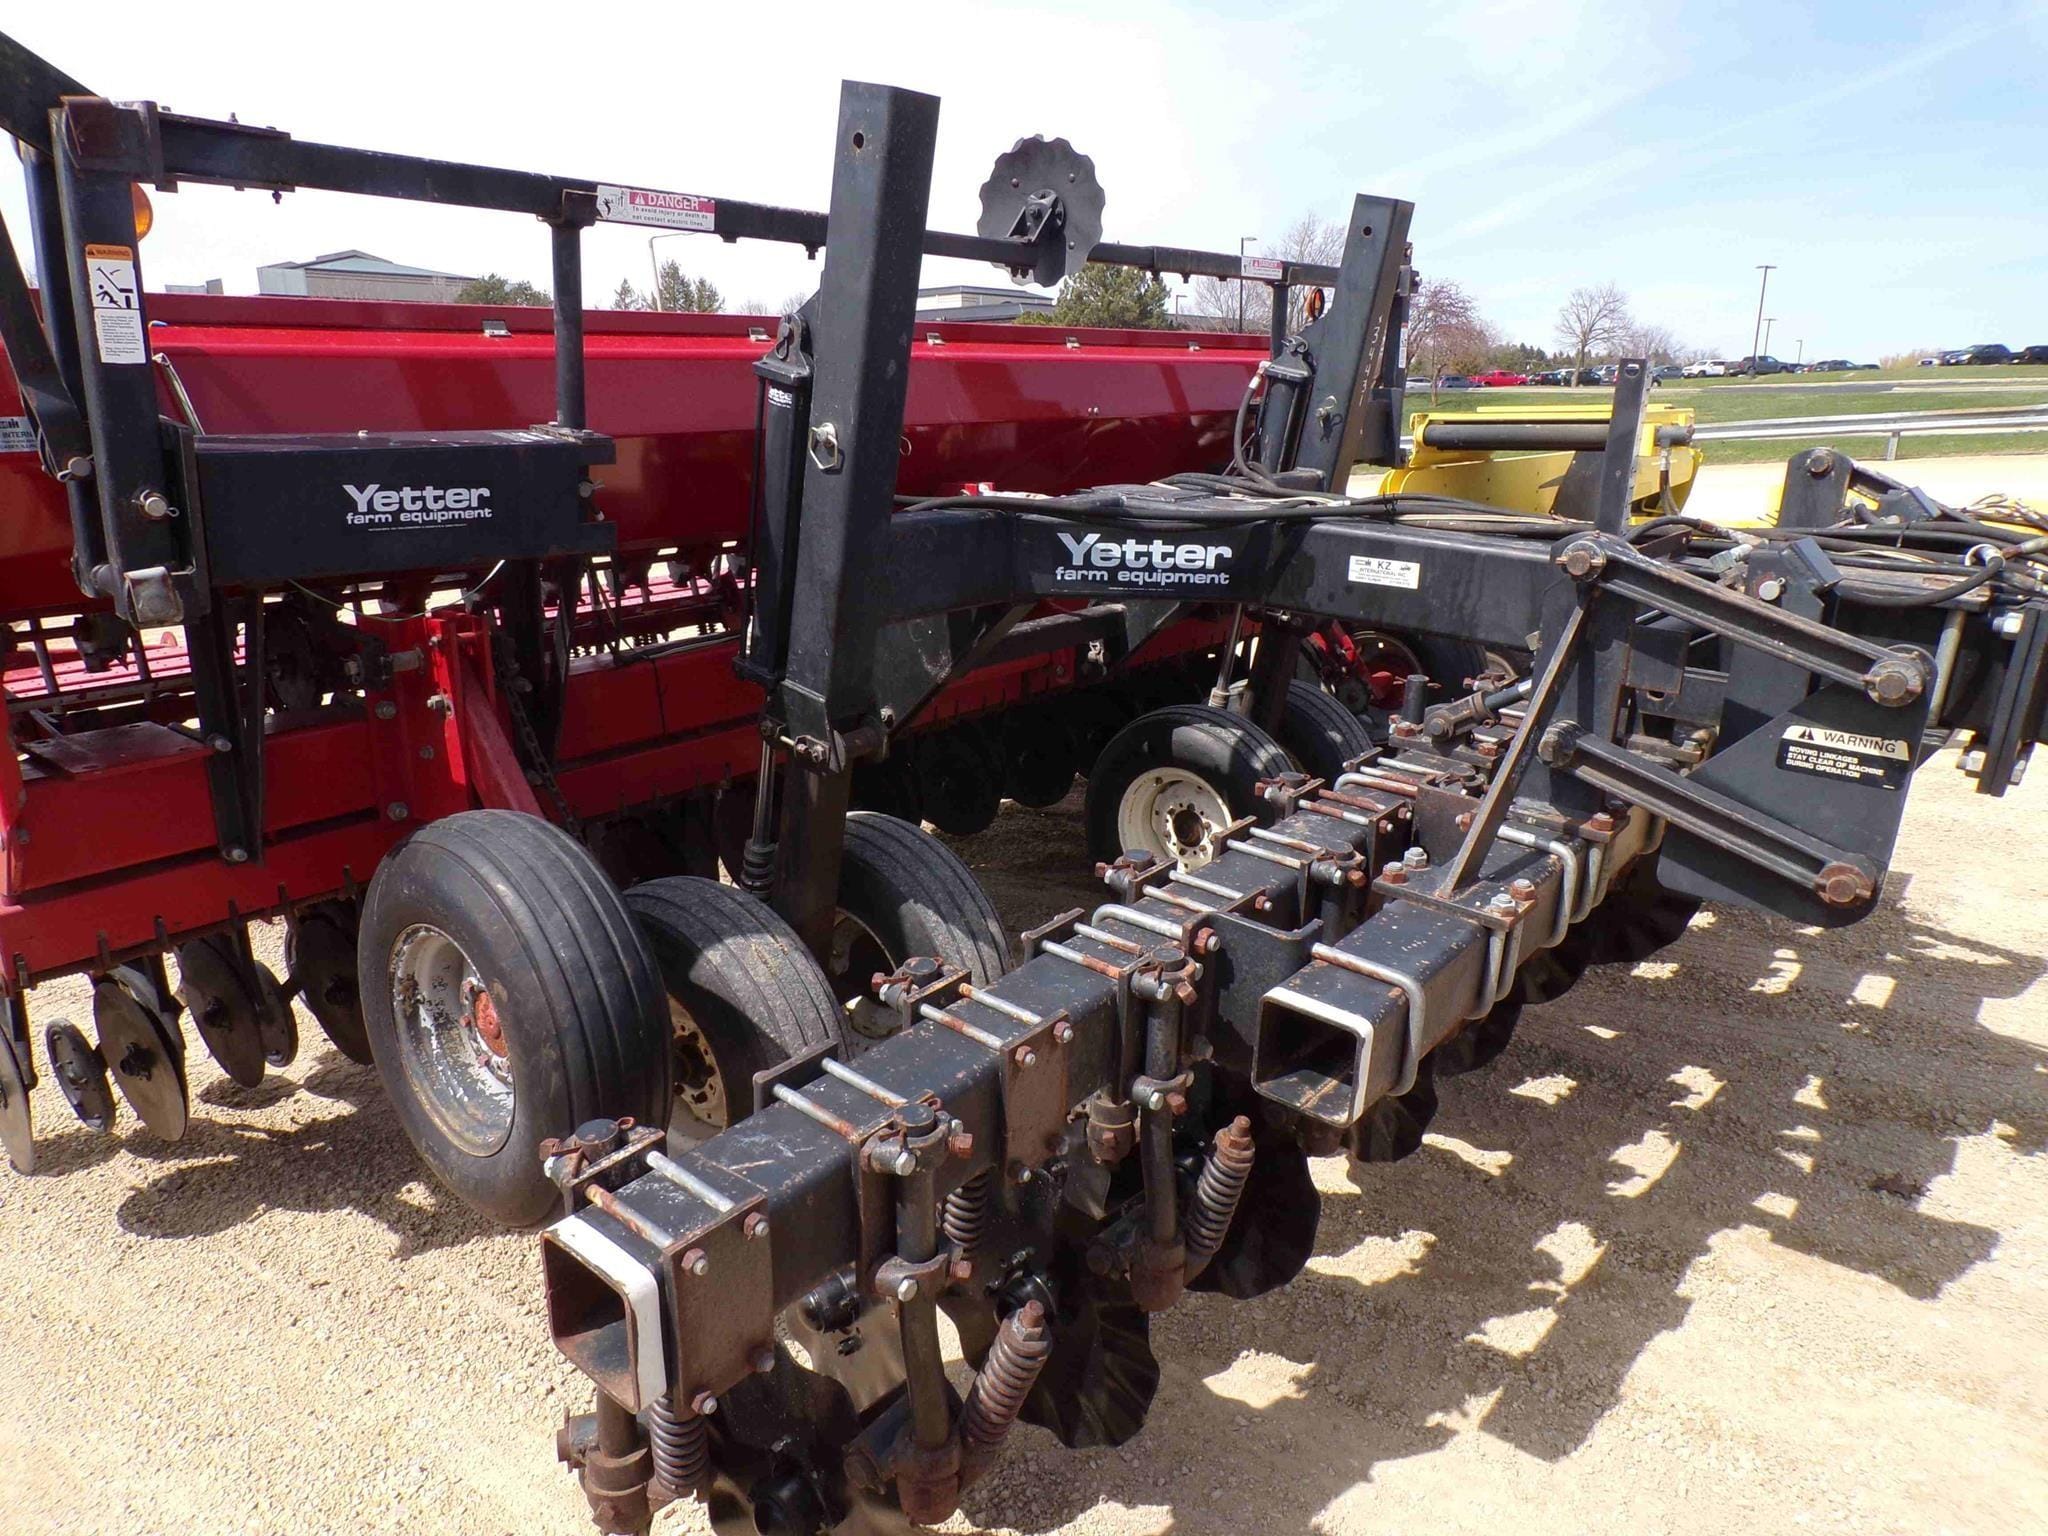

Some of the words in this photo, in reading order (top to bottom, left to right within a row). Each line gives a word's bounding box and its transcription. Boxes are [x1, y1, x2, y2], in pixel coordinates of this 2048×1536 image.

[648, 194, 700, 211] DANGER
[644, 215, 667, 223] contact
[667, 216, 689, 225] electric
[659, 208, 676, 217] injury
[685, 211, 701, 220] death
[342, 484, 491, 513] Yetter
[346, 512, 393, 525] farm
[399, 507, 493, 524] equipment
[1057, 532, 1233, 570] Yetter
[1377, 560, 1392, 571] KZ
[1055, 566, 1109, 582] farm
[1117, 569, 1230, 586] equipment
[1823, 731, 1896, 754] WARNING
[1787, 752, 1807, 762] STAY
[1808, 756, 1835, 767] CLEAR
[1848, 763, 1885, 777] MACHINE
[1788, 745, 1818, 757] MOVING
[1819, 749, 1859, 765] LINKAGES
[1785, 759, 1815, 770] DURING
[1816, 764, 1861, 779] OPERATION
